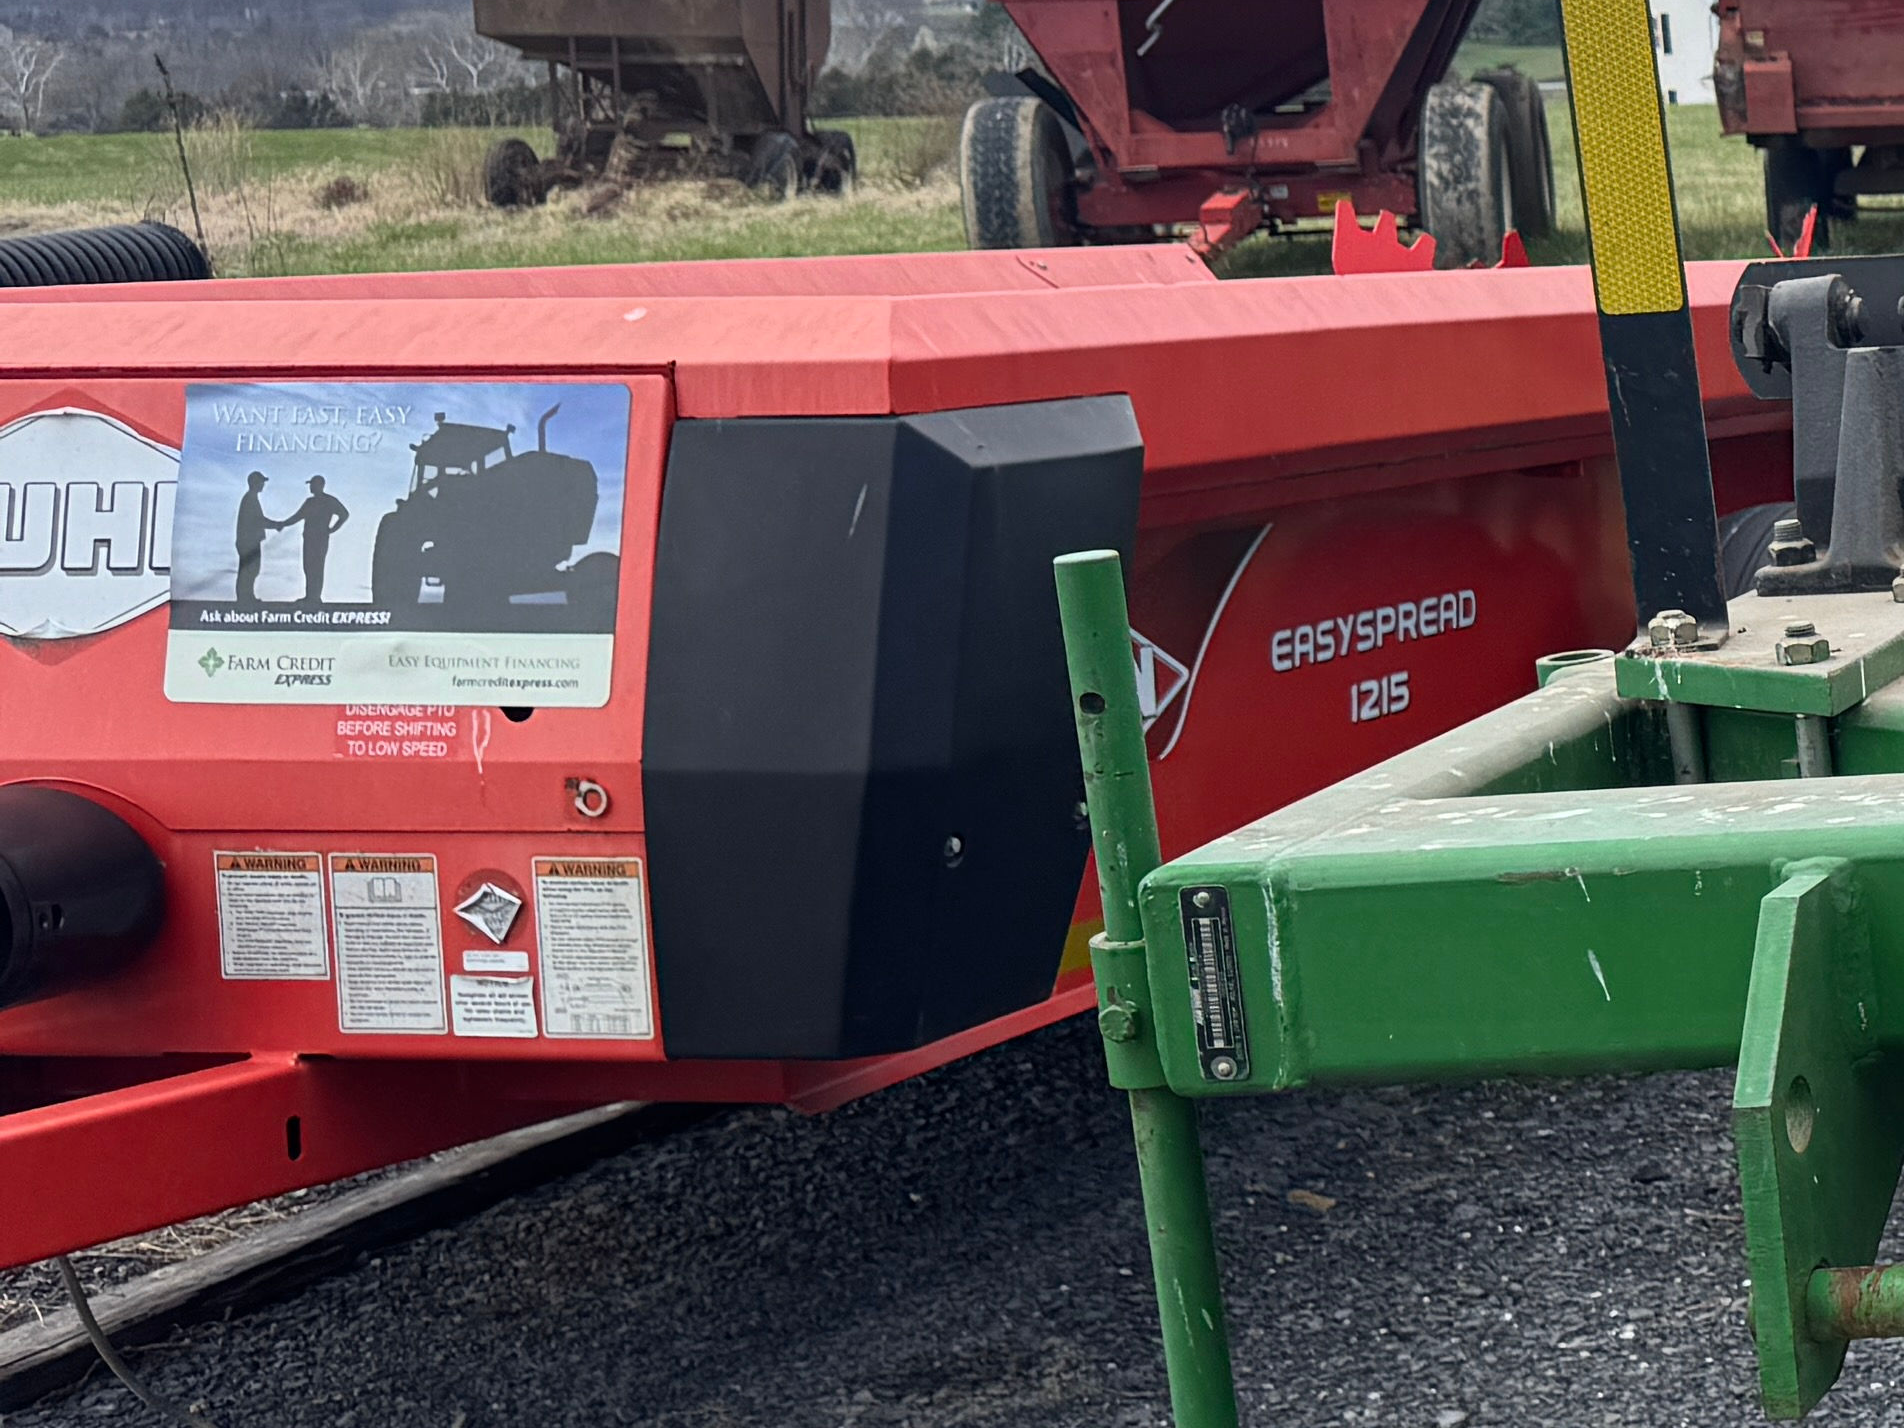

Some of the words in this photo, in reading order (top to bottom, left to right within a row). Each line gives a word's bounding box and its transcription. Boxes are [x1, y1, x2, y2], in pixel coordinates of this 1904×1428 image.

[212, 402, 283, 425] WANT
[291, 404, 348, 428] FAST,
[356, 404, 413, 425] EASY
[235, 431, 383, 453] FINANCING?
[200, 609, 222, 623] Ask
[223, 609, 258, 623] about
[261, 610, 290, 623] Farm
[293, 610, 330, 624] Credit
[331, 611, 391, 625] EXPRESS!
[1270, 589, 1477, 673] EASYSPREAD
[228, 655, 271, 671] FARM
[276, 655, 336, 671] CREDIT
[388, 655, 420, 668] EASY
[424, 655, 500, 670] EQUIPMENT
[504, 656, 581, 670] FINANCING
[274, 674, 332, 688] EXPRESS
[451, 676, 579, 690] farmcreditexpress.com
[1350, 671, 1411, 724] 1215
[345, 704, 424, 717] DISENGAGE
[336, 720, 393, 737] BEFORE
[394, 721, 457, 738] SHIFTING
[347, 740, 366, 756] TO
[368, 740, 400, 756] LOW
[402, 741, 448, 757] SPEED
[244, 858, 307, 870] WARNING
[358, 858, 421, 872] WARNING
[563, 862, 627, 877] WARNING
